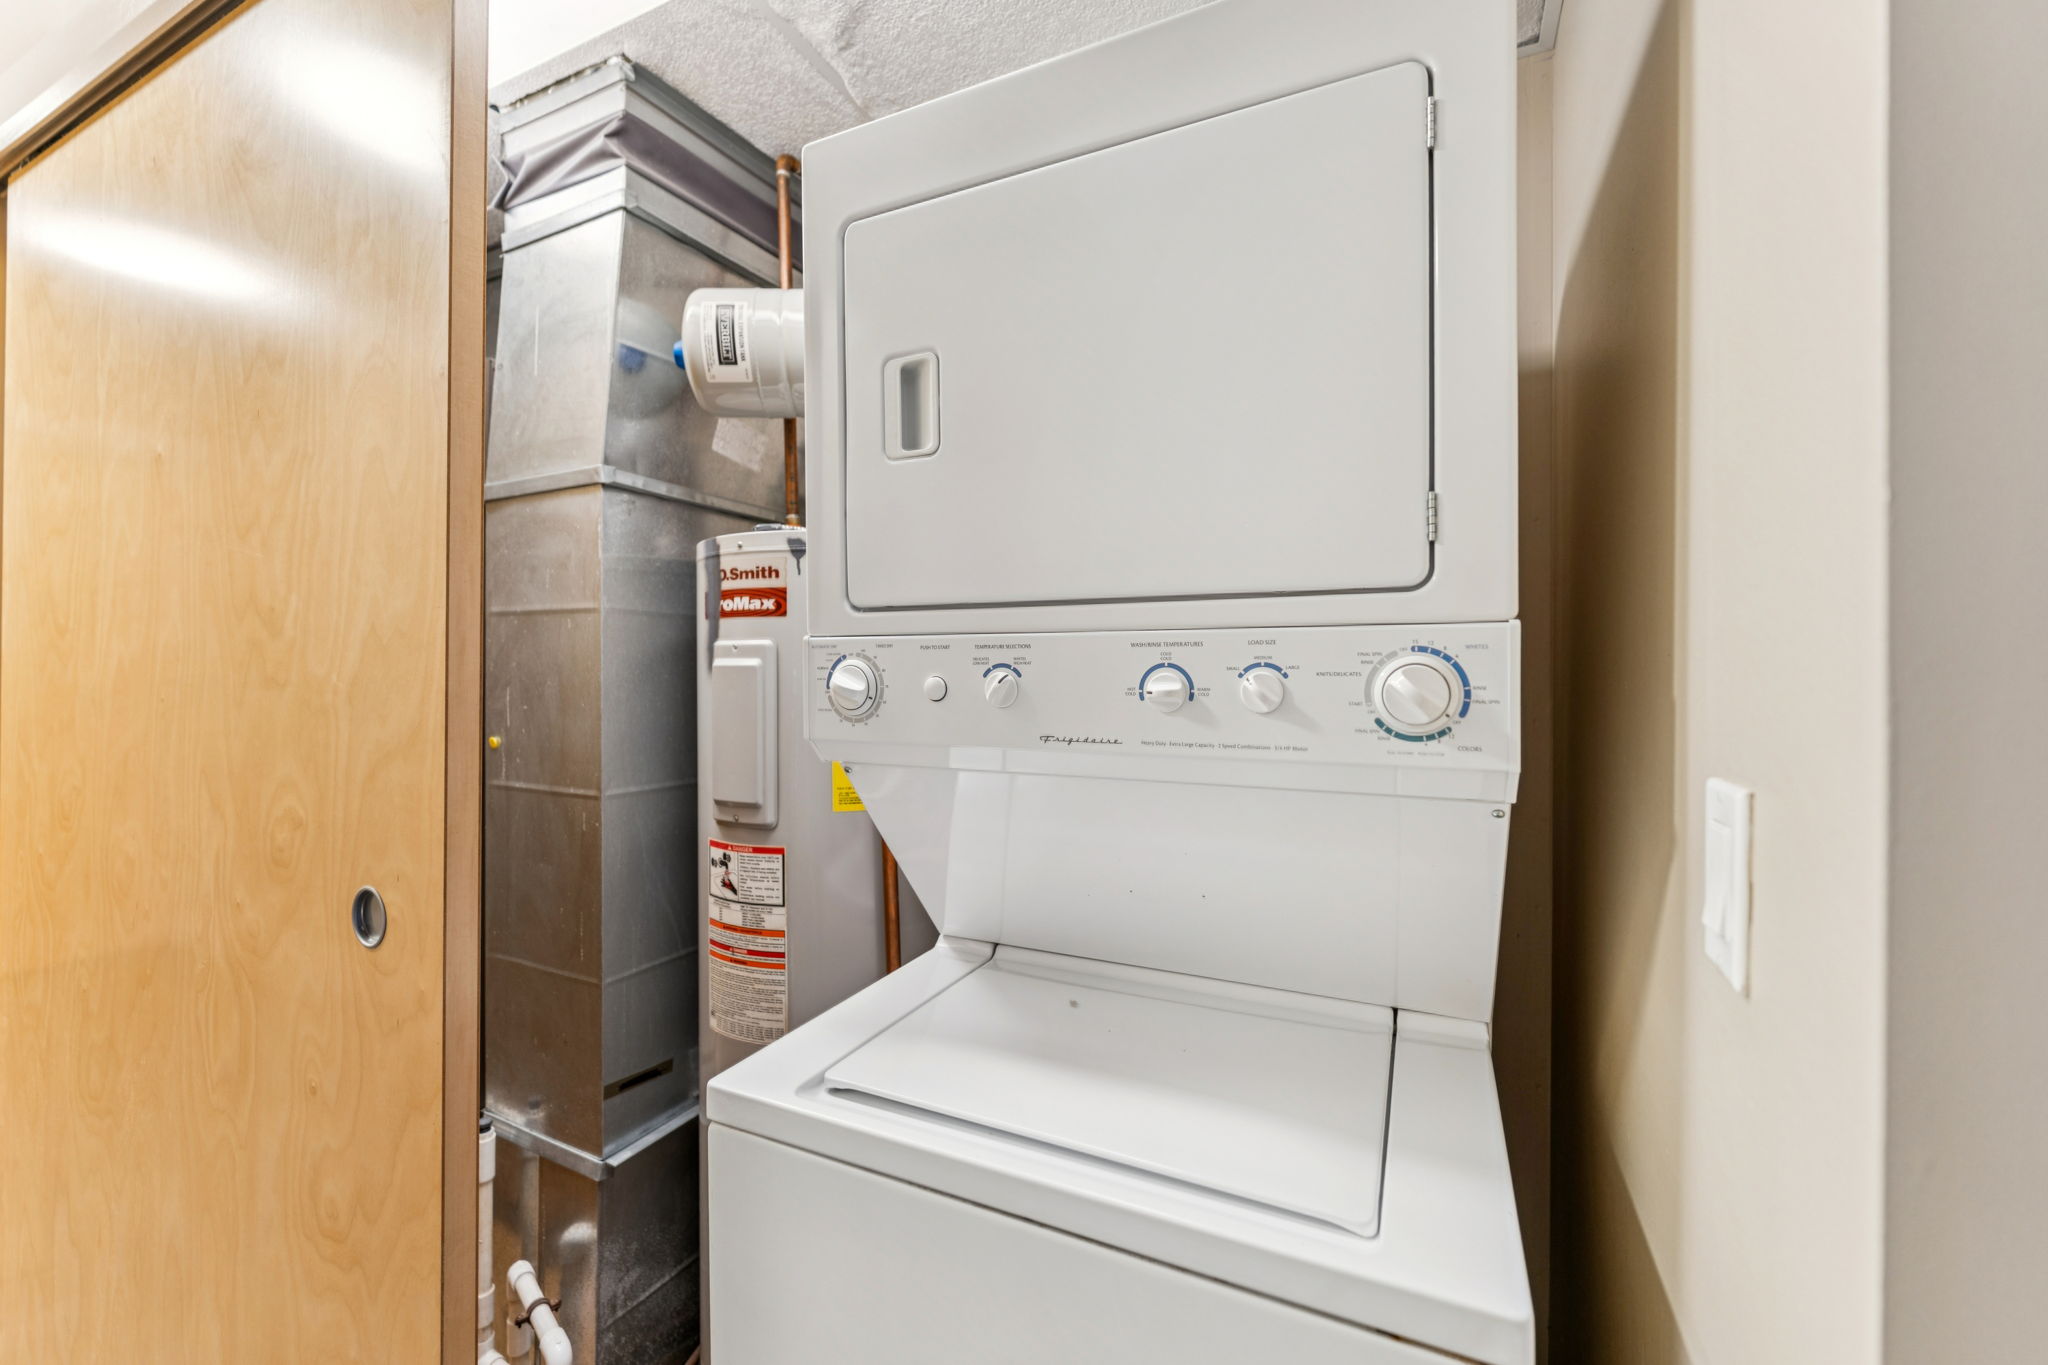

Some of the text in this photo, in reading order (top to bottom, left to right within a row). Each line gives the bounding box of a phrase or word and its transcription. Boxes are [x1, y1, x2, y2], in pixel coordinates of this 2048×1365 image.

[719, 308, 733, 360] EVERBILT
[719, 566, 780, 581] O.Smith
[1039, 735, 1123, 746] Frigidaire
[732, 845, 753, 853] DANGER
